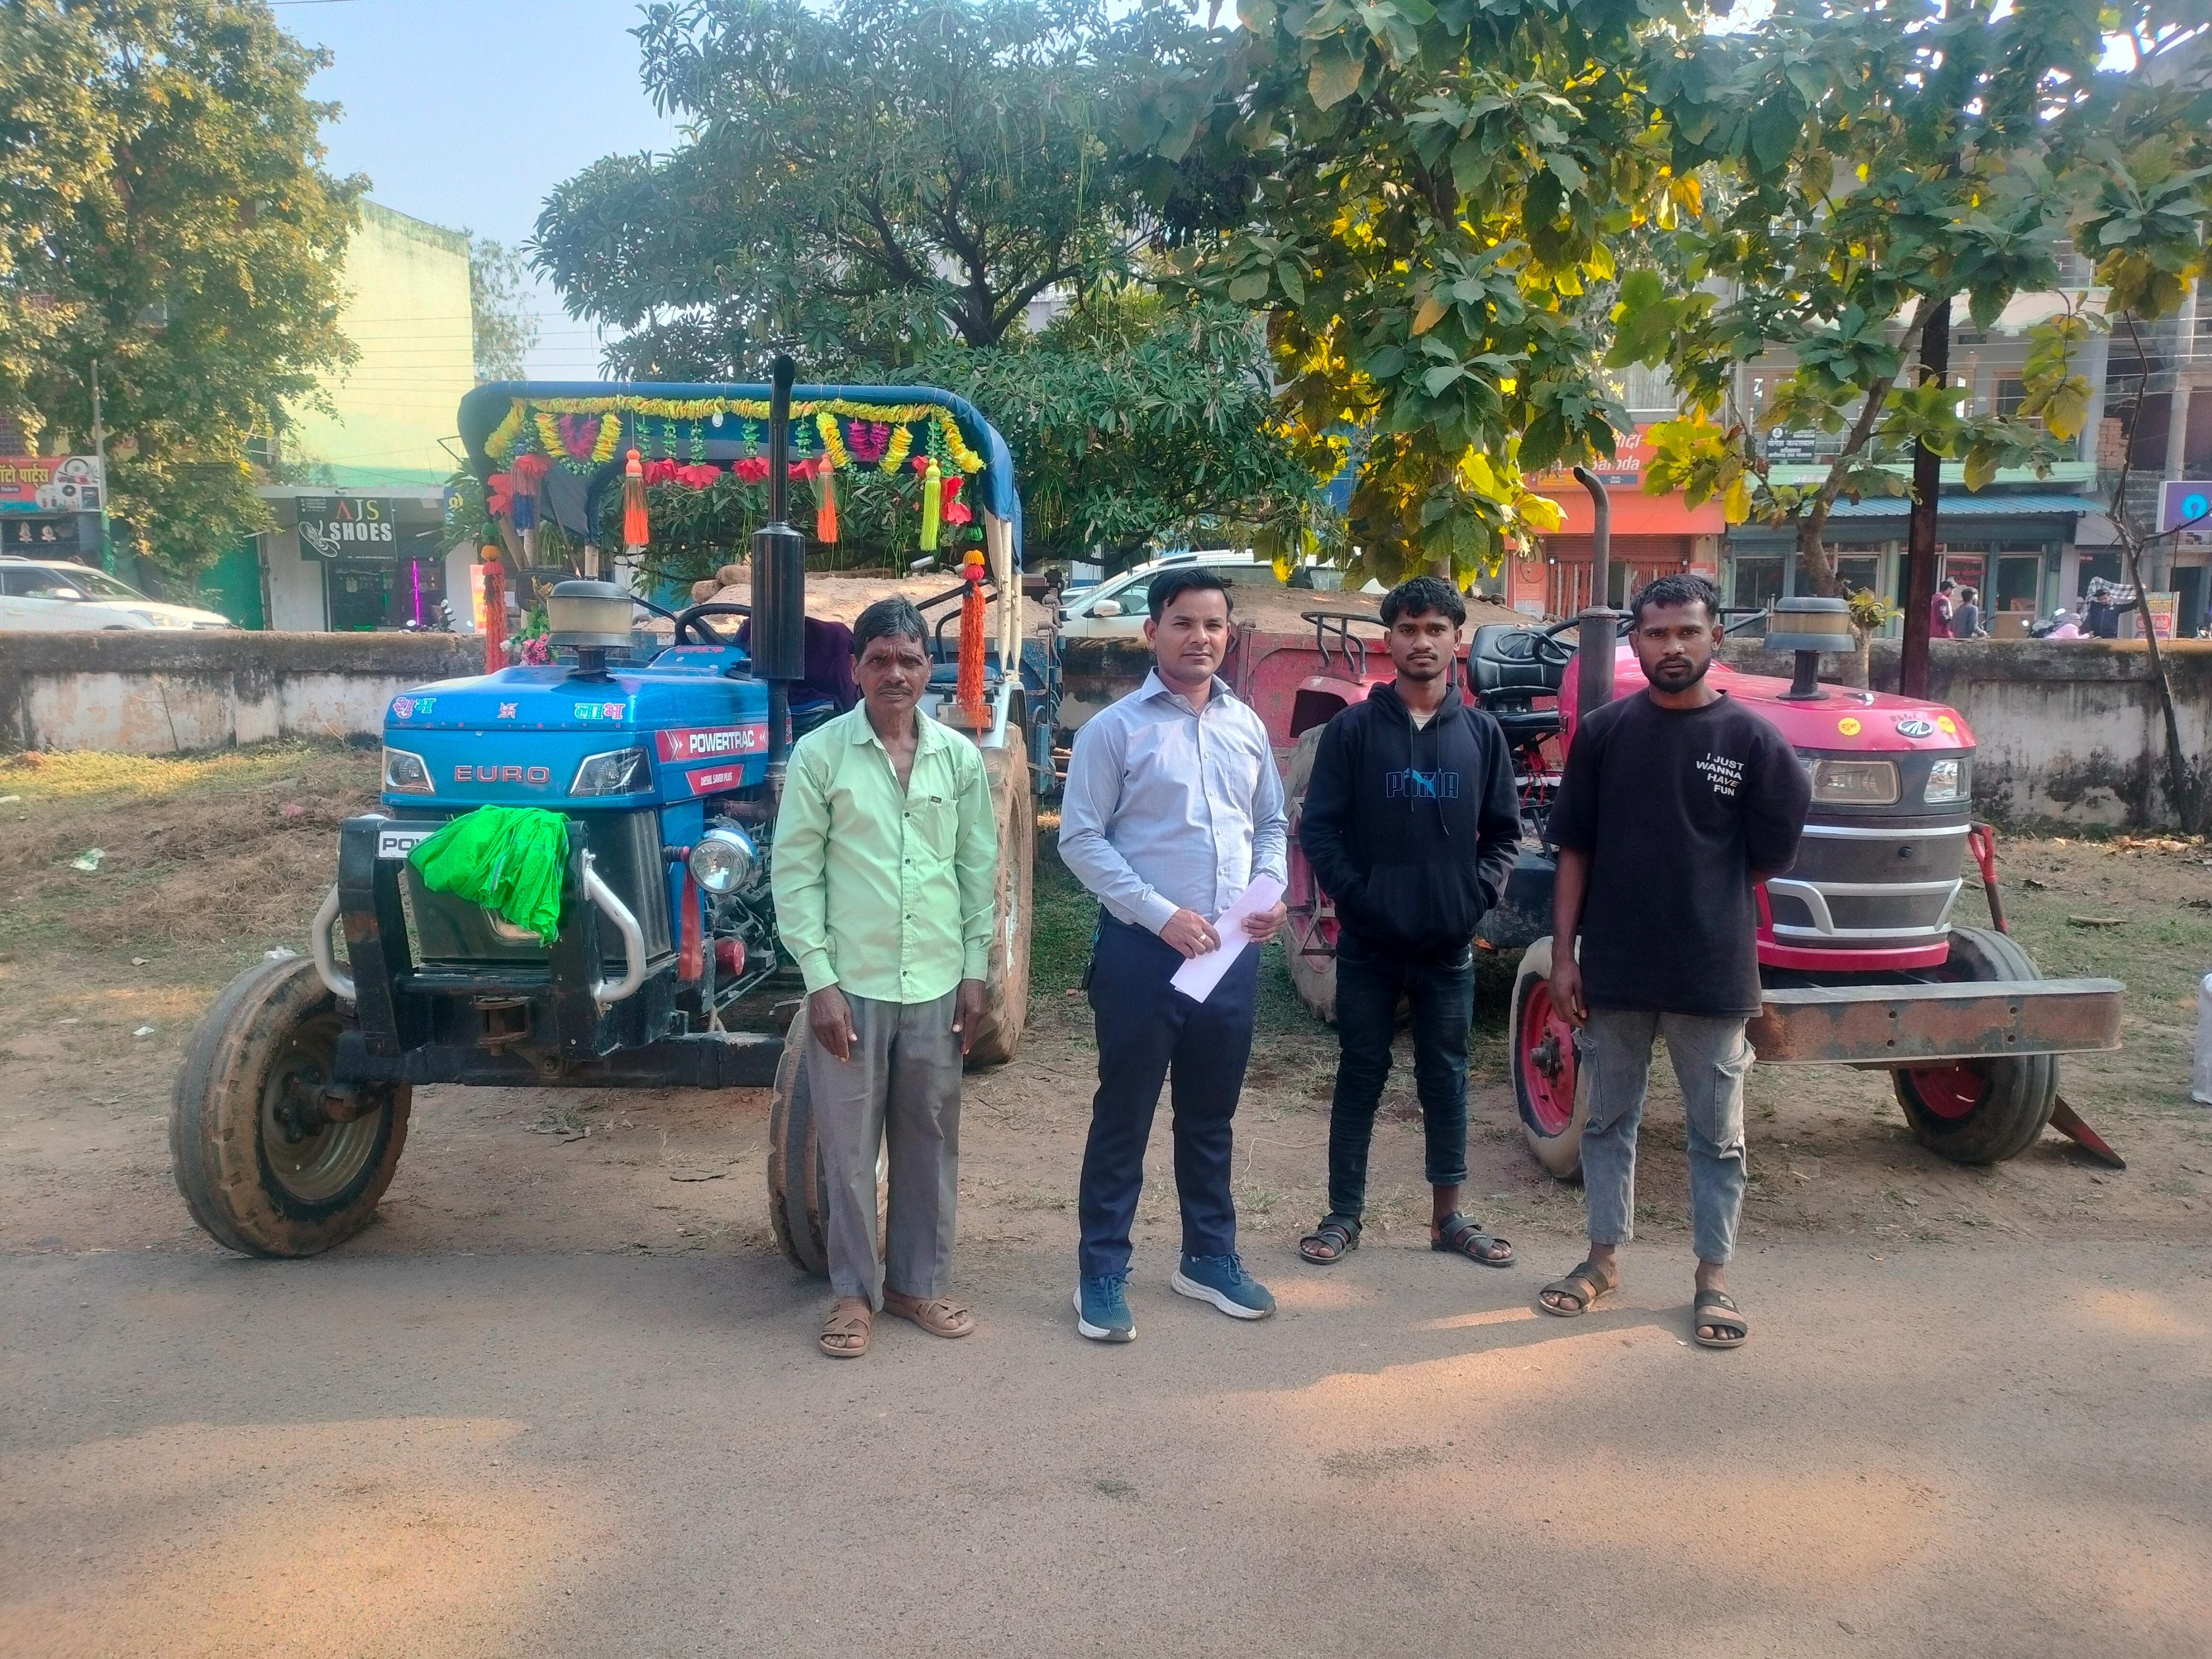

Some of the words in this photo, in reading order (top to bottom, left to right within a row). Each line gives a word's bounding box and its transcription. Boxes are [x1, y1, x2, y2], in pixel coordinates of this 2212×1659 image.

[336, 499, 380, 522] AJS
[329, 522, 392, 542] SHOES
[393, 697, 437, 719] शुभ
[574, 702, 626, 719] लाभ
[689, 730, 755, 754] POWERTRAC
[1696, 760, 1742, 781] WANNA
[1713, 756, 1745, 770] JUST
[454, 765, 550, 783] EURO
[724, 772, 733, 782] PLUS
[1707, 773, 1740, 787] HAVE
[1386, 771, 1459, 798] PUMA
[1714, 784, 1735, 797] FUN
[382, 837, 420, 851] PO
